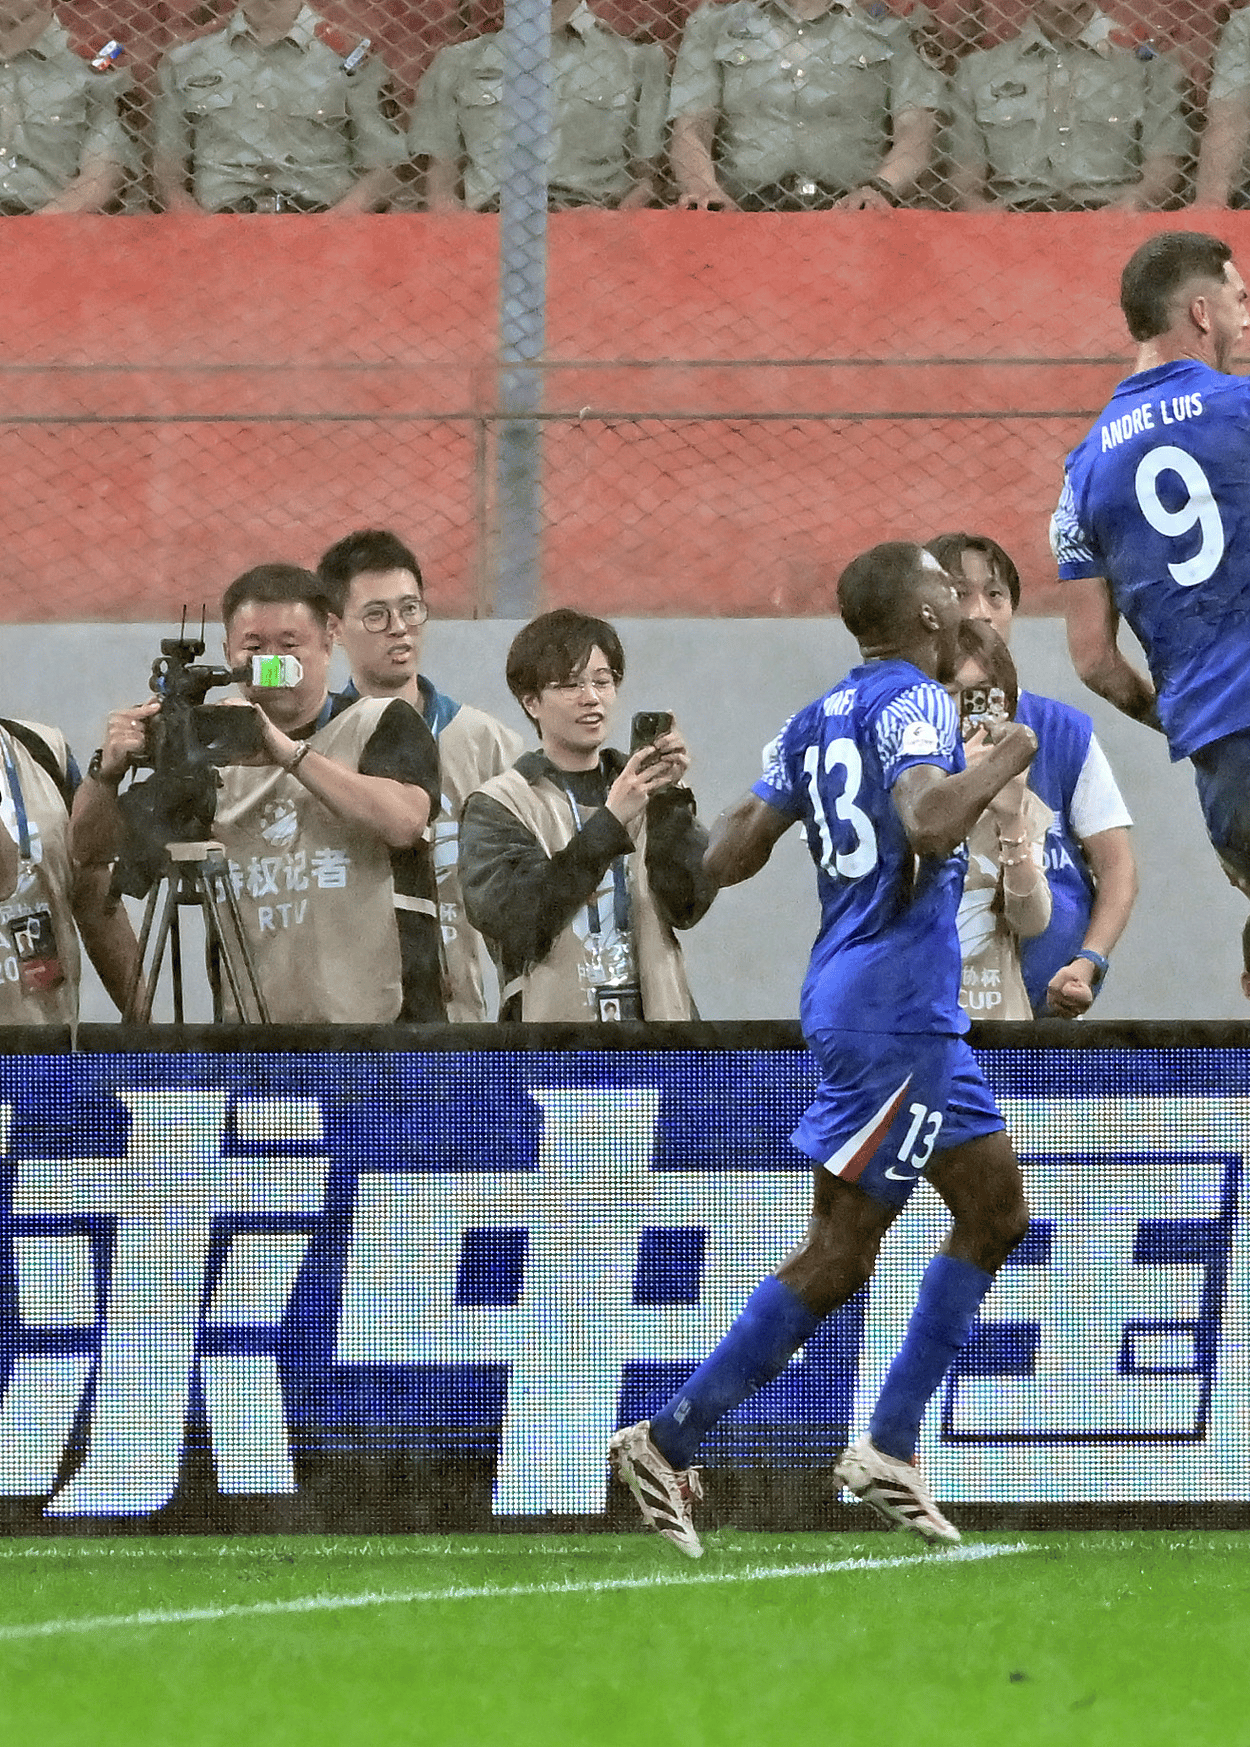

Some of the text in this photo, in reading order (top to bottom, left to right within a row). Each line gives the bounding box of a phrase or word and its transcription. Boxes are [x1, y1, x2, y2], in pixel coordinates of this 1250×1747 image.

[1101, 393, 1204, 453] ANDRE LUIS
[1135, 445, 1225, 587] 9
[803, 737, 878, 879] 13
[258, 898, 307, 932] RTV
[897, 1102, 943, 1169] 13
